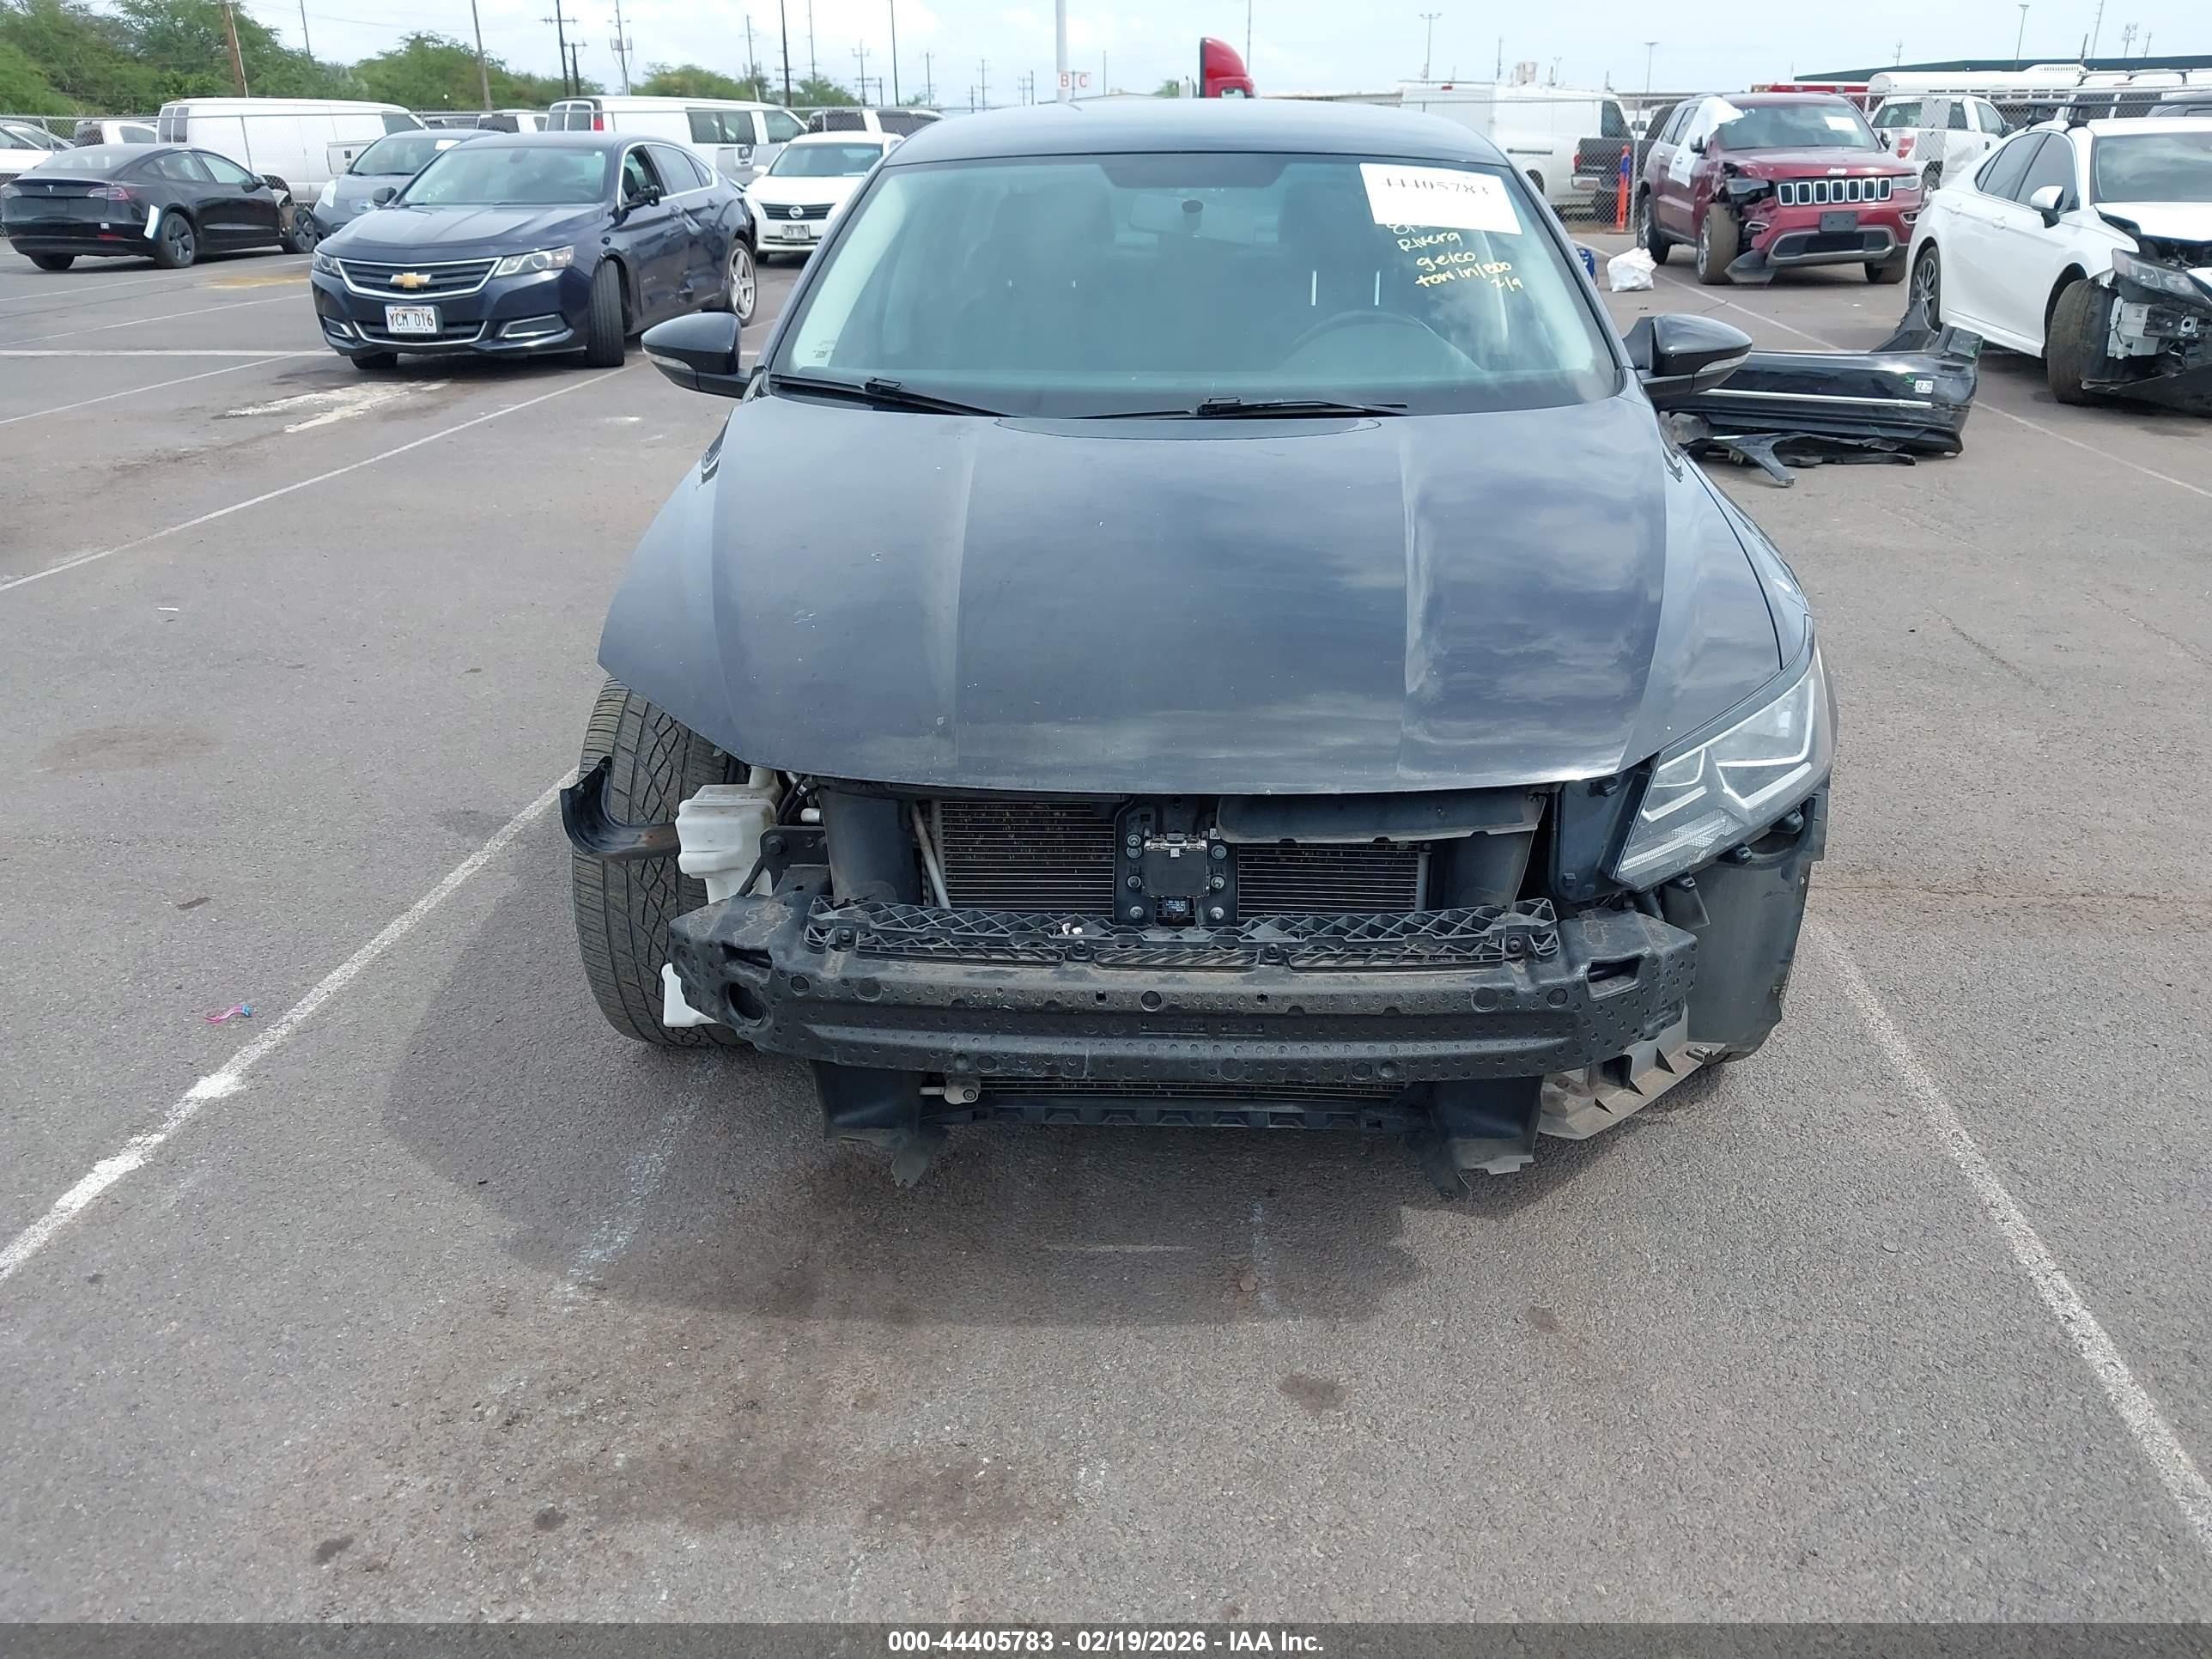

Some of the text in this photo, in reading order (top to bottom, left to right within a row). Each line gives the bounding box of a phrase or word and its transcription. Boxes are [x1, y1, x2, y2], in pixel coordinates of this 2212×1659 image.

[1060, 74, 1070, 88] B
[1079, 74, 1088, 88] C
[1491, 276, 1523, 292] 2/9
[389, 313, 434, 326] YCM 016
